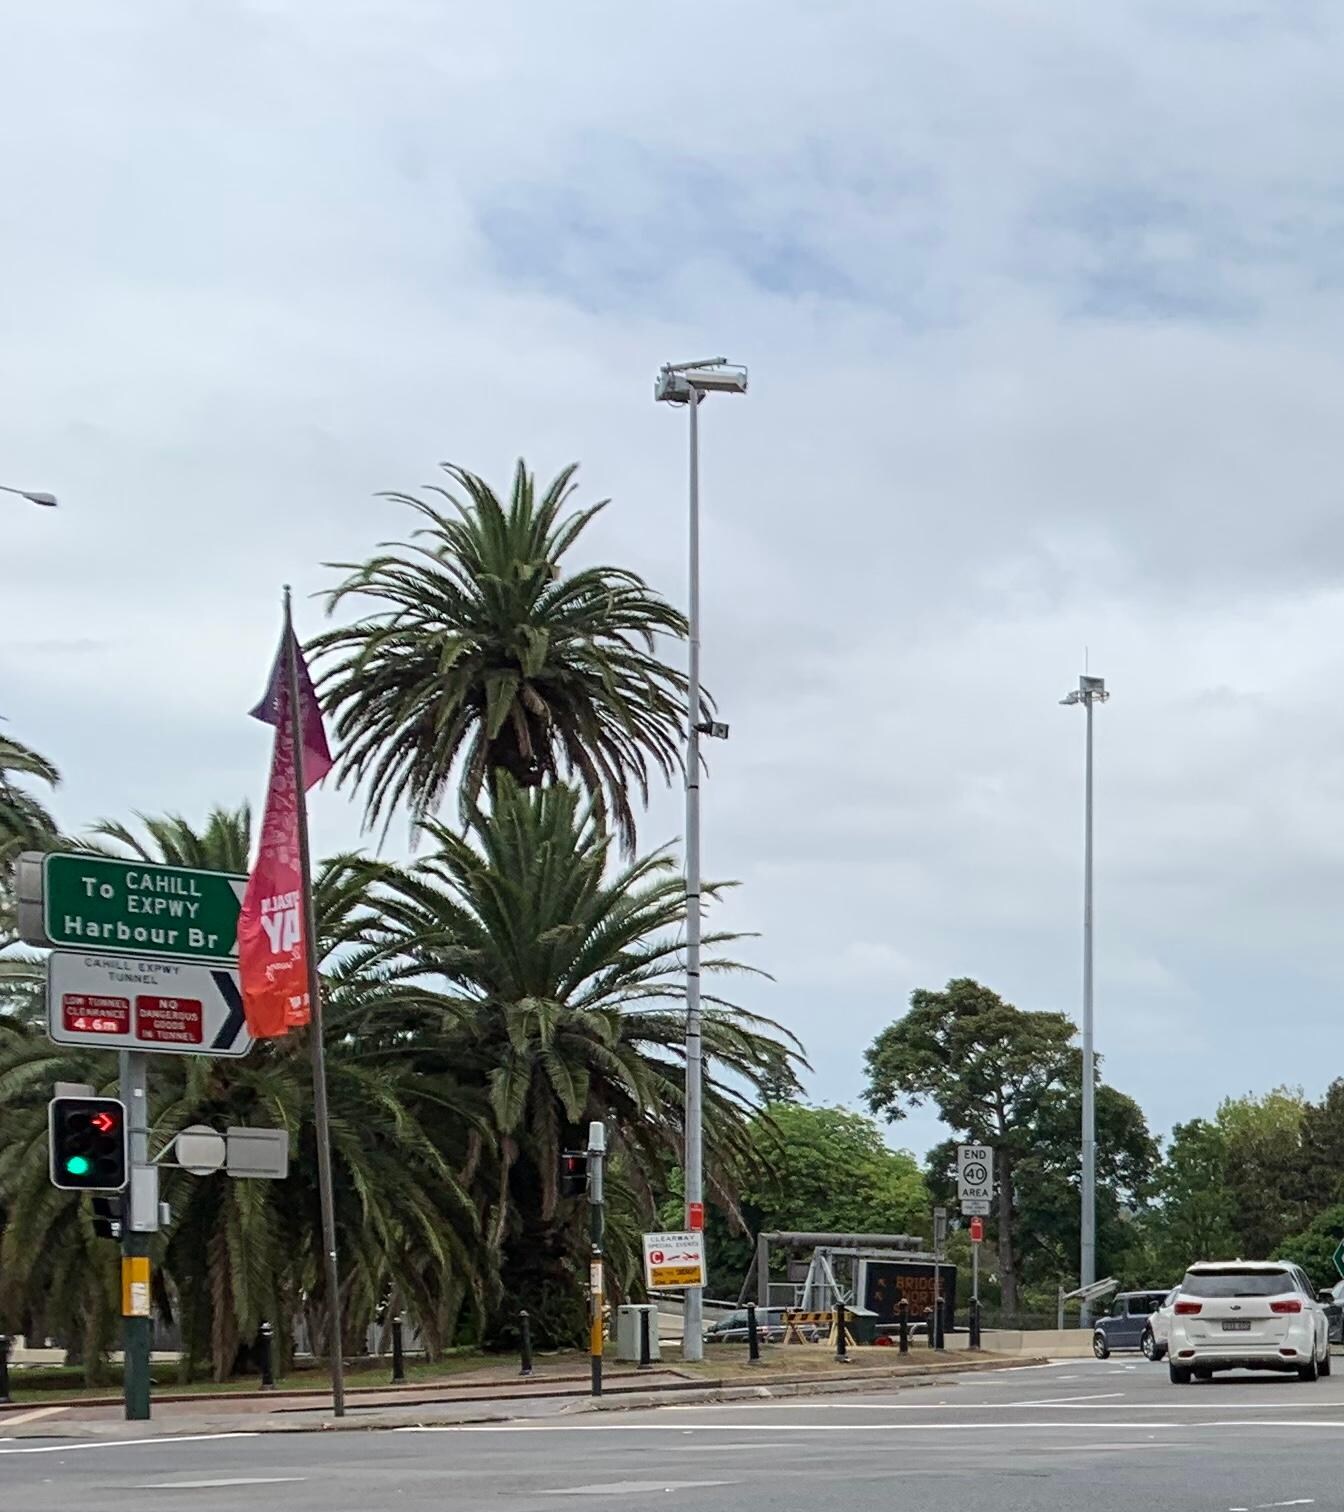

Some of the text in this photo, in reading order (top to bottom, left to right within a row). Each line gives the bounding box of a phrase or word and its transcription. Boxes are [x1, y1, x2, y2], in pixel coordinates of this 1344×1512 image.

[81, 871, 202, 899] To CAHILL
[127, 895, 200, 919] EXPWY
[64, 915, 219, 949] Harbour Br
[84, 957, 180, 975] CAHILL EXPWY
[108, 972, 158, 985] TUNNEL
[64, 996, 128, 1009] LOW TUNNEL
[158, 1000, 179, 1010] NO
[66, 1006, 126, 1019] CLEARANCE
[139, 1009, 199, 1022] DANGEROUS
[73, 1017, 118, 1031] 4.6m
[157, 1031, 195, 1042] TUNNEL
[963, 1149, 987, 1160] END
[965, 1168, 986, 1180] 40
[962, 1188, 988, 1197] AREA
[650, 1235, 695, 1243] CLEARWAY
[651, 1252, 662, 1263] C
